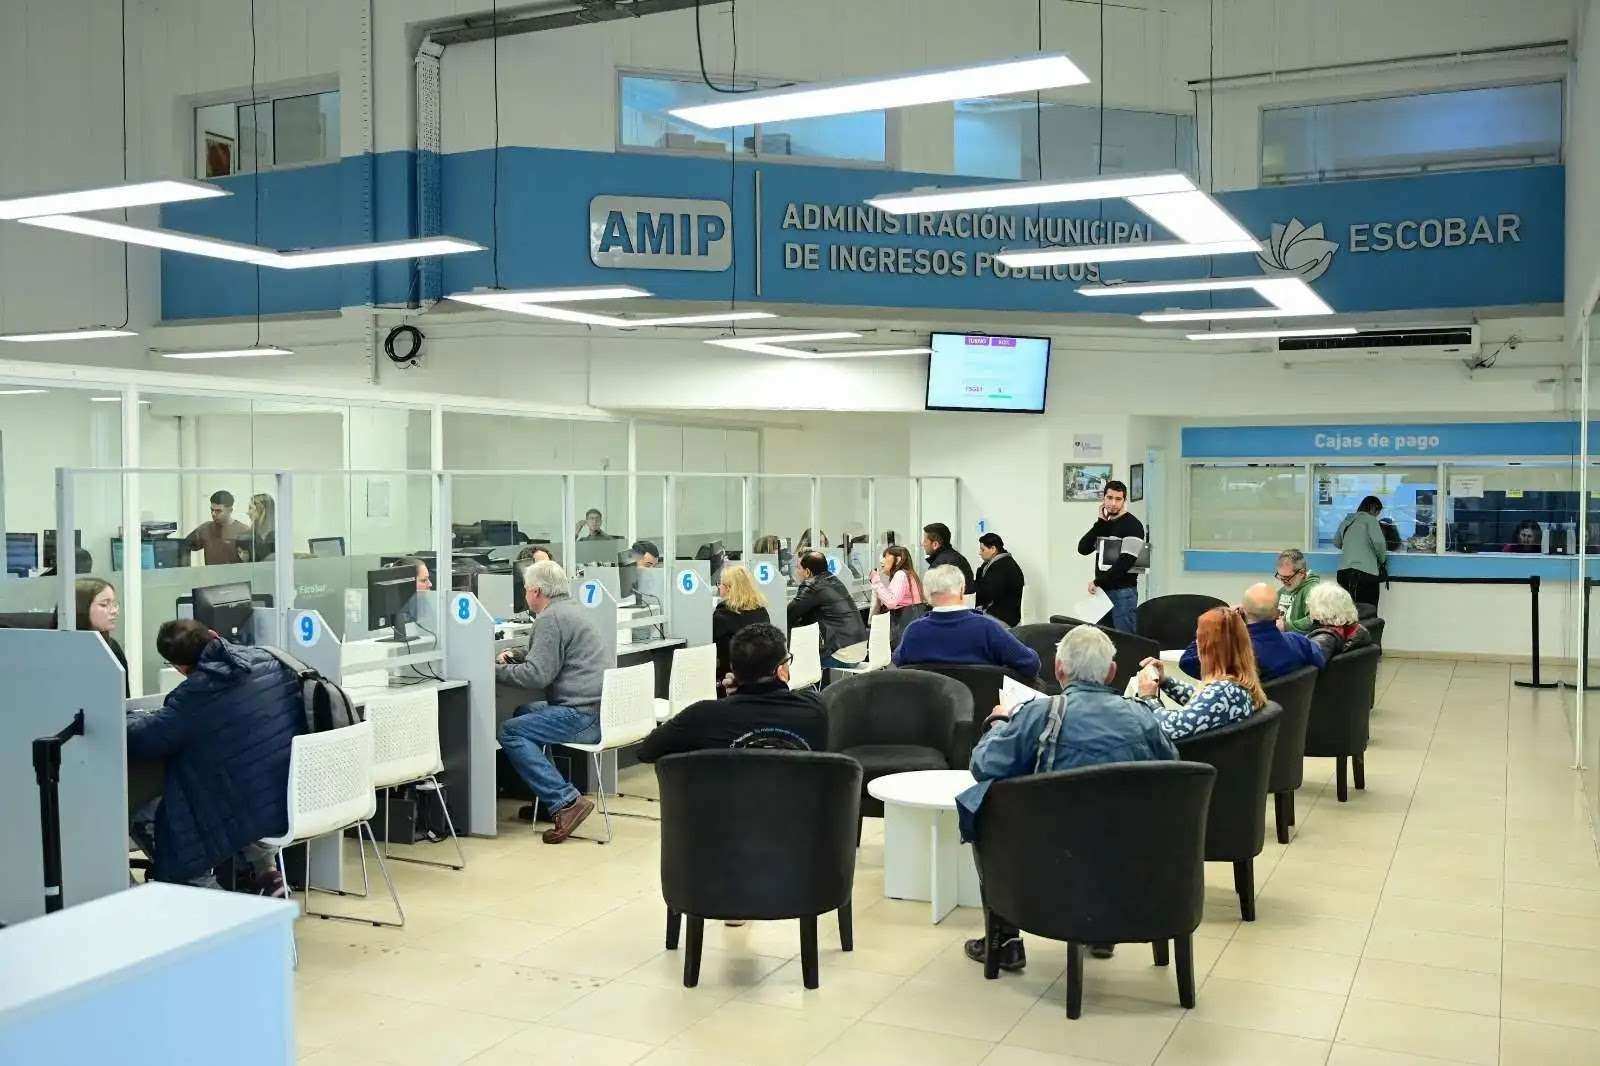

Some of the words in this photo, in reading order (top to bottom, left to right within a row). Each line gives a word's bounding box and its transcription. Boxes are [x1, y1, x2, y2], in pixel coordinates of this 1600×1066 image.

[599, 210, 726, 257] AMIP
[782, 202, 1016, 241] ADMINISTRACIÓN
[1349, 214, 1520, 252] ESCOBAR
[784, 242, 820, 270] DE
[829, 244, 968, 278] INGRESOS
[1314, 433, 1363, 450] Cajas
[1367, 432, 1389, 448] de
[1394, 435, 1440, 451] pago
[682, 573, 693, 592] 6
[759, 565, 769, 583] 5
[585, 584, 596, 604] 7
[458, 597, 470, 620] 8
[301, 616, 314, 642] 9
